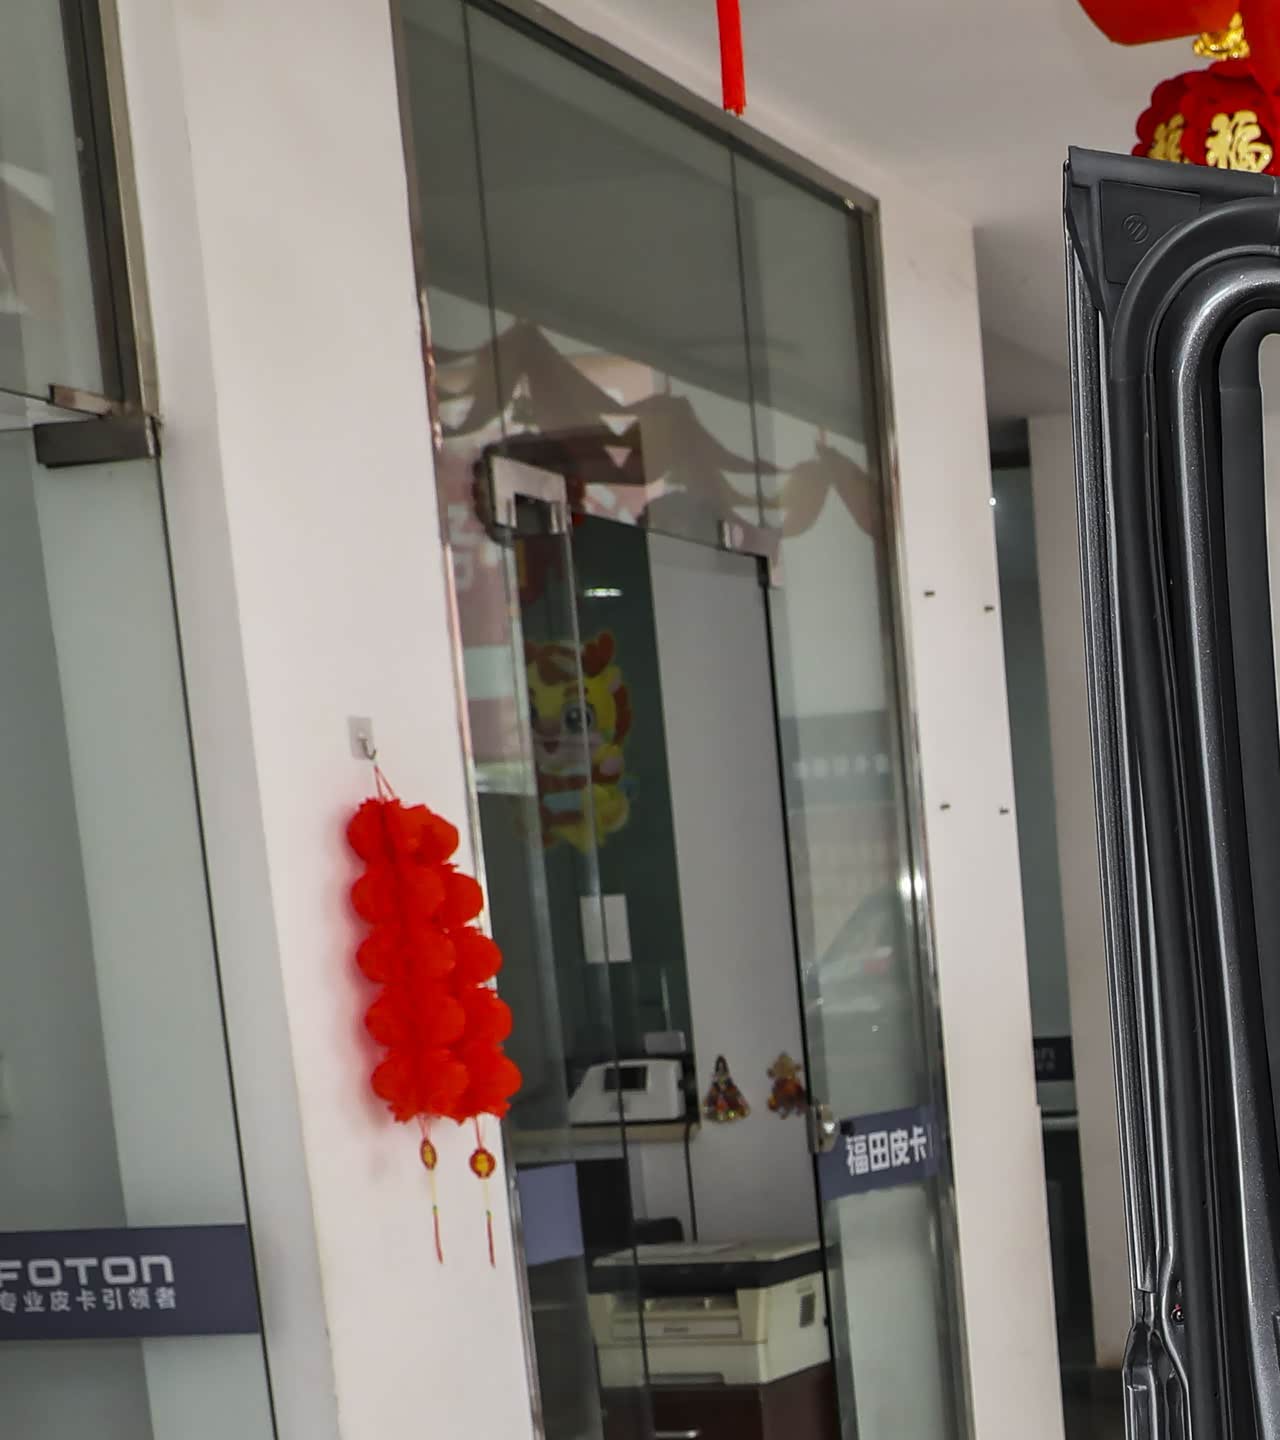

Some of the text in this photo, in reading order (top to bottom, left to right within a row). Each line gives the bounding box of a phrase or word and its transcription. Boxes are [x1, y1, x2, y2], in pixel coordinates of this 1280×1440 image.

[846, 1126, 927, 1176] 福田皮卡
[0, 1255, 174, 1287] FOTON
[0, 1287, 176, 1313] 专业皮卡引领者
